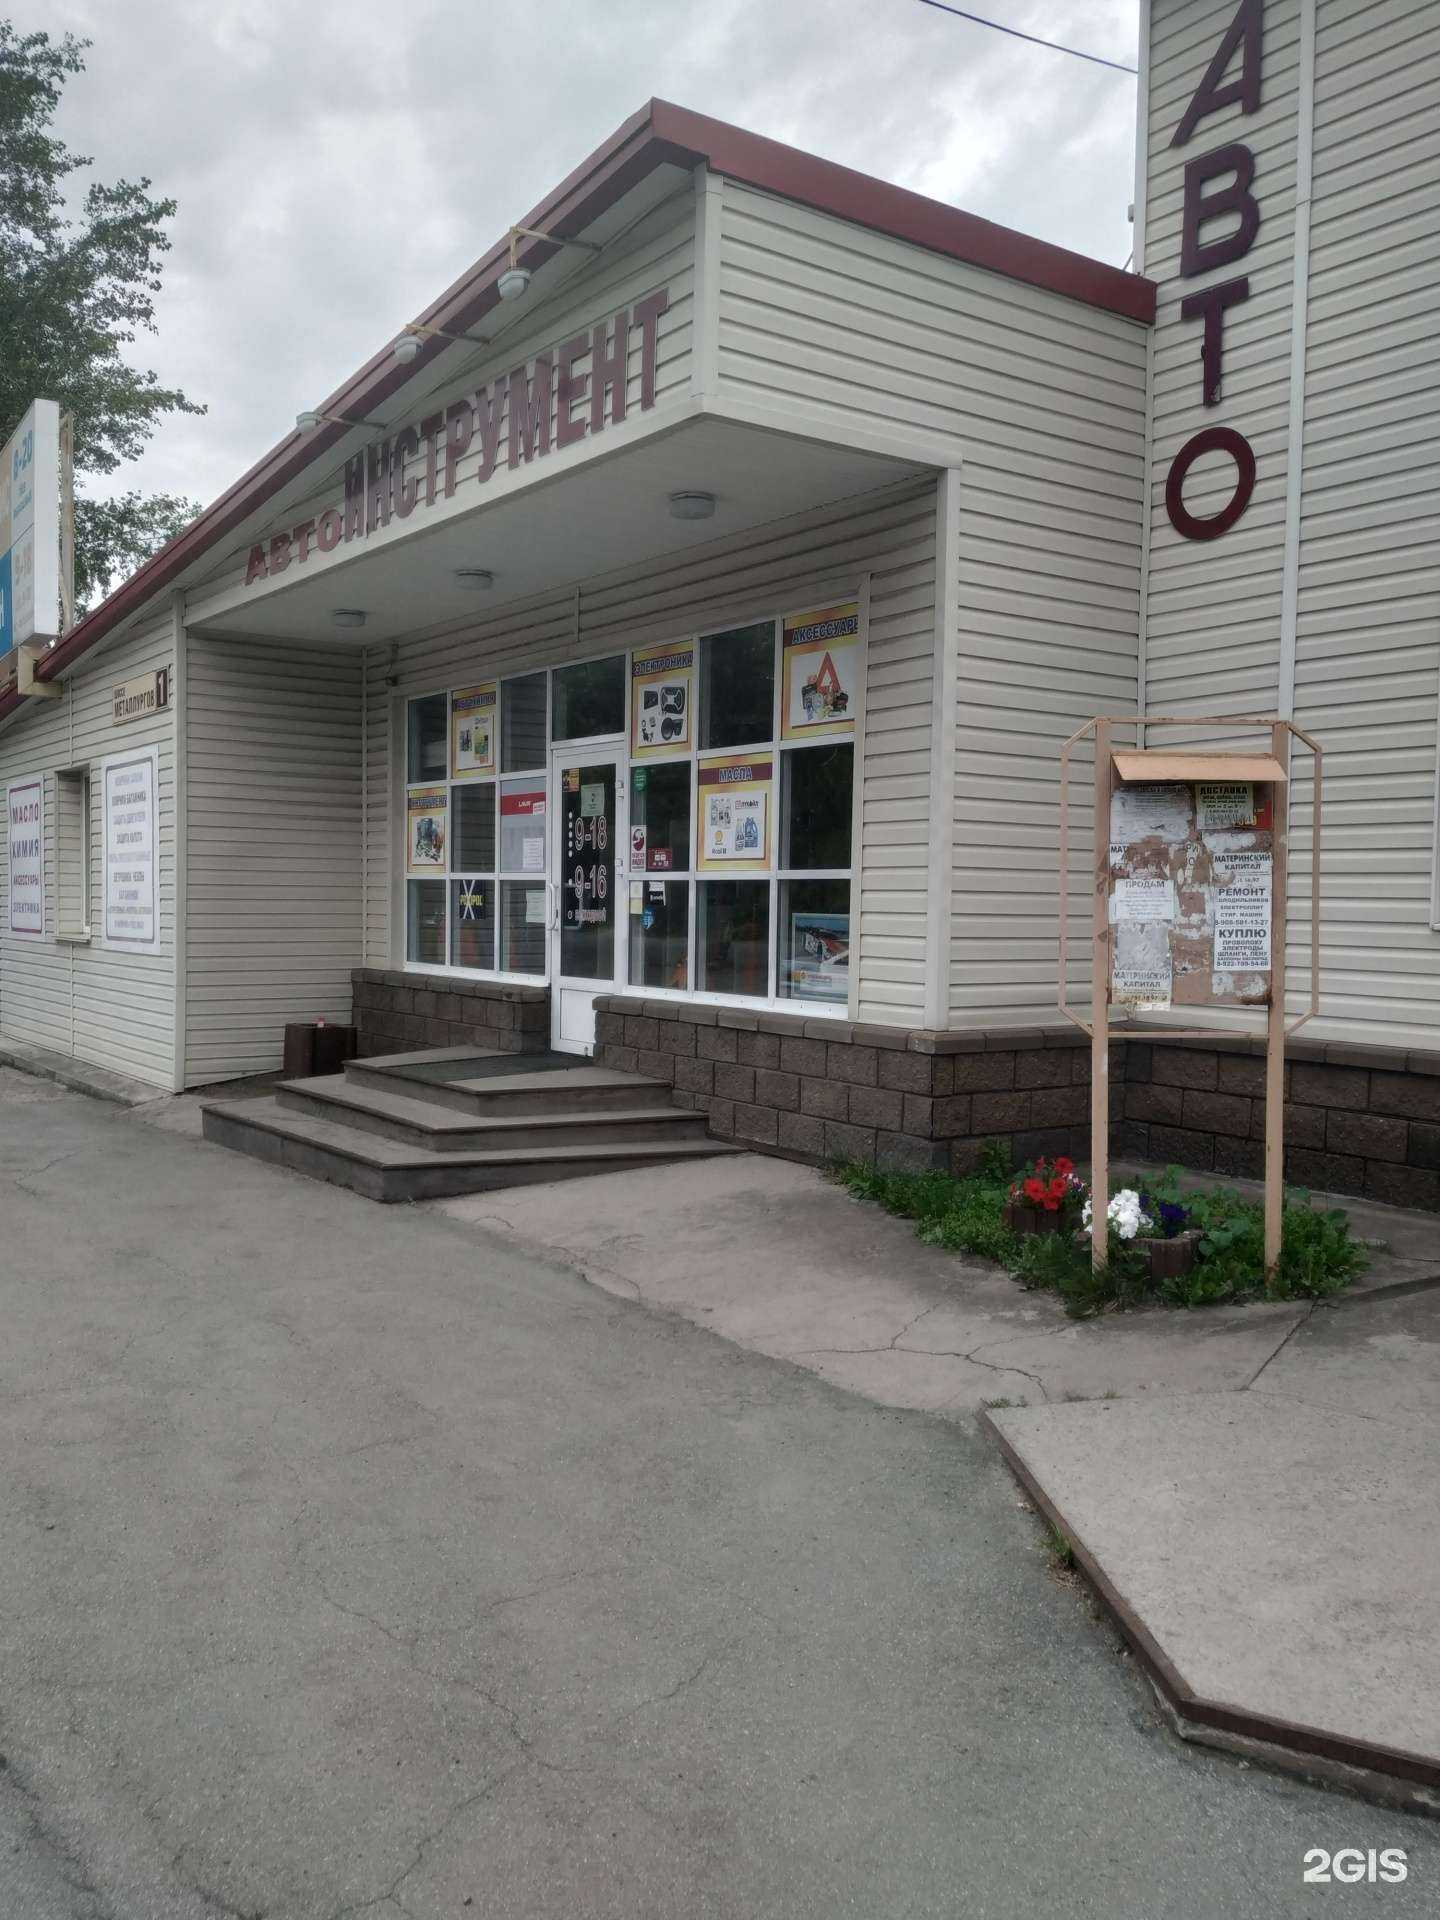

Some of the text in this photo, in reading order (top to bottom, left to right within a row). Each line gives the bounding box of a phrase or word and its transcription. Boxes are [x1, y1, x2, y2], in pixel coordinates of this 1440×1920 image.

[1165, 0, 1264, 541] АВТО
[633, 653, 693, 675] ЭЛЕКТРОНИКА
[114, 672, 164, 718] МЕТАЛЛУРГОВ 1
[719, 767, 753, 782] МАСЛА
[1200, 786, 1247, 795] ДОСТАВКА
[12, 802, 39, 824] МАСЛО
[575, 816, 607, 850] 9-18
[12, 839, 39, 859] ХИМИЯ
[1215, 853, 1271, 863] МАТЕРИНСКИЙ
[575, 864, 607, 898] 9-16
[1126, 880, 1165, 889] ПРОДАМ
[1218, 888, 1266, 896] РЕМОНТ
[1219, 929, 1267, 939] КУПЛЮ
